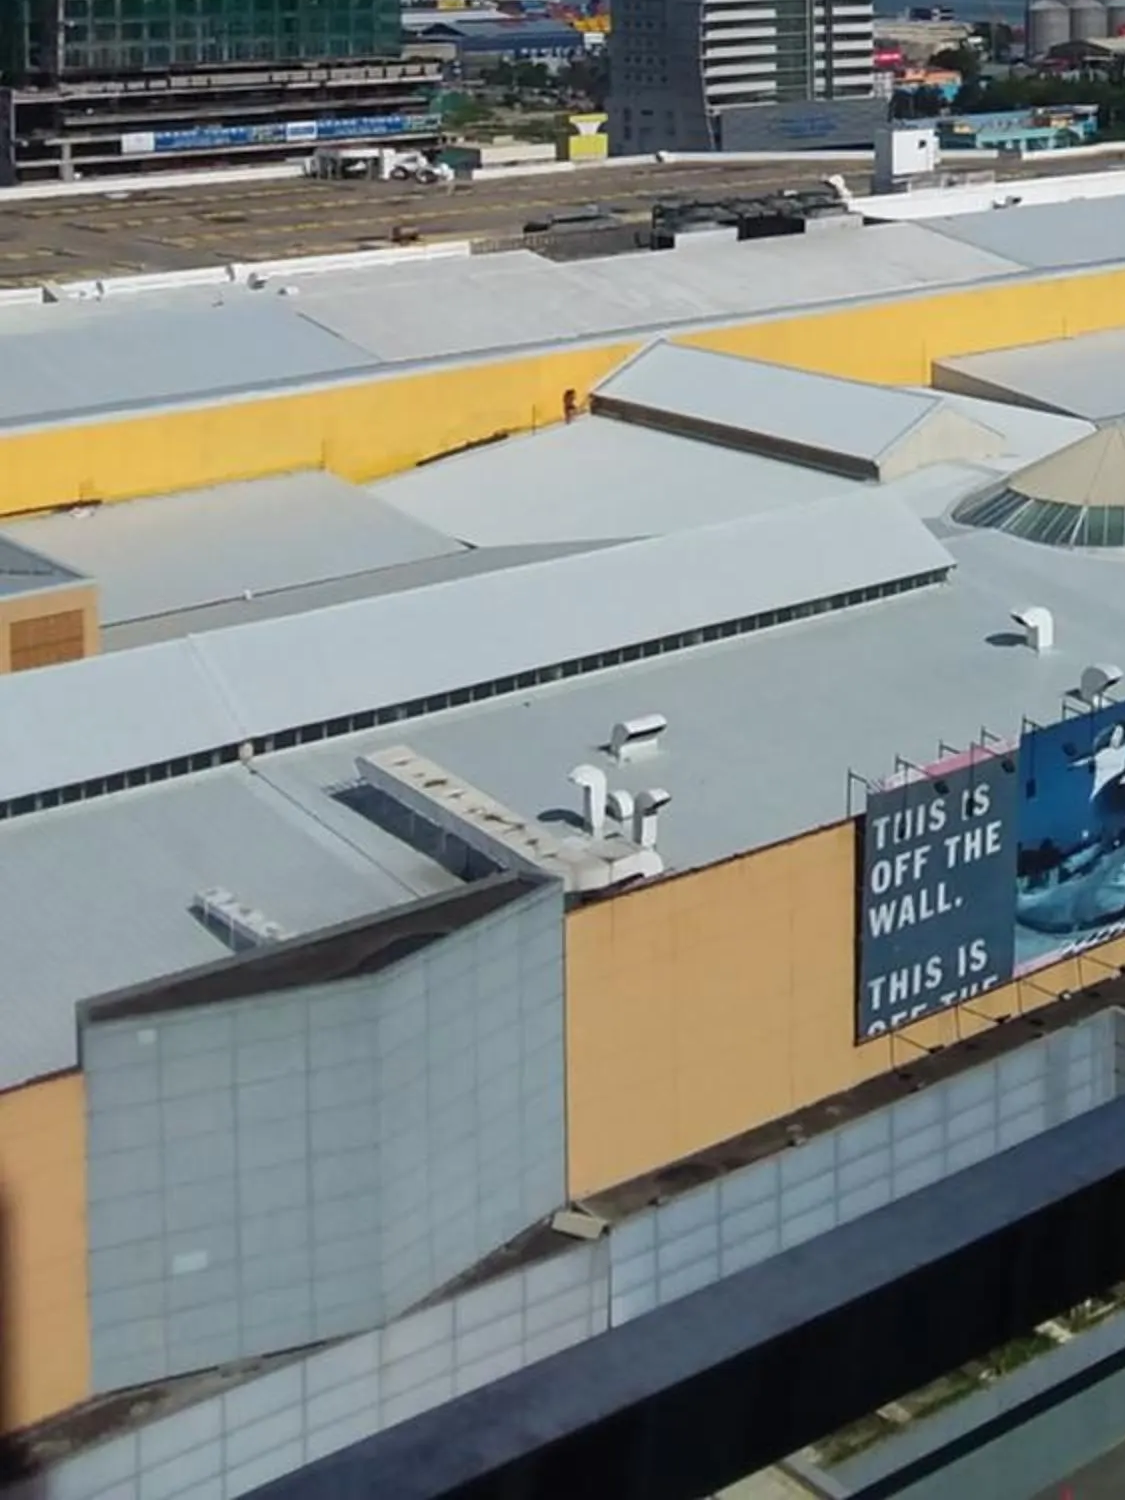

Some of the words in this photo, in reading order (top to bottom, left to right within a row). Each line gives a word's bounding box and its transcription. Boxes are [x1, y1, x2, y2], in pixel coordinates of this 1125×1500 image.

[872, 797, 947, 850] THIS
[870, 844, 932, 895] OFF
[943, 819, 1003, 869] THE
[868, 881, 964, 939] WALL.
[867, 954, 944, 1011] THIS
[957, 938, 989, 978] IS
